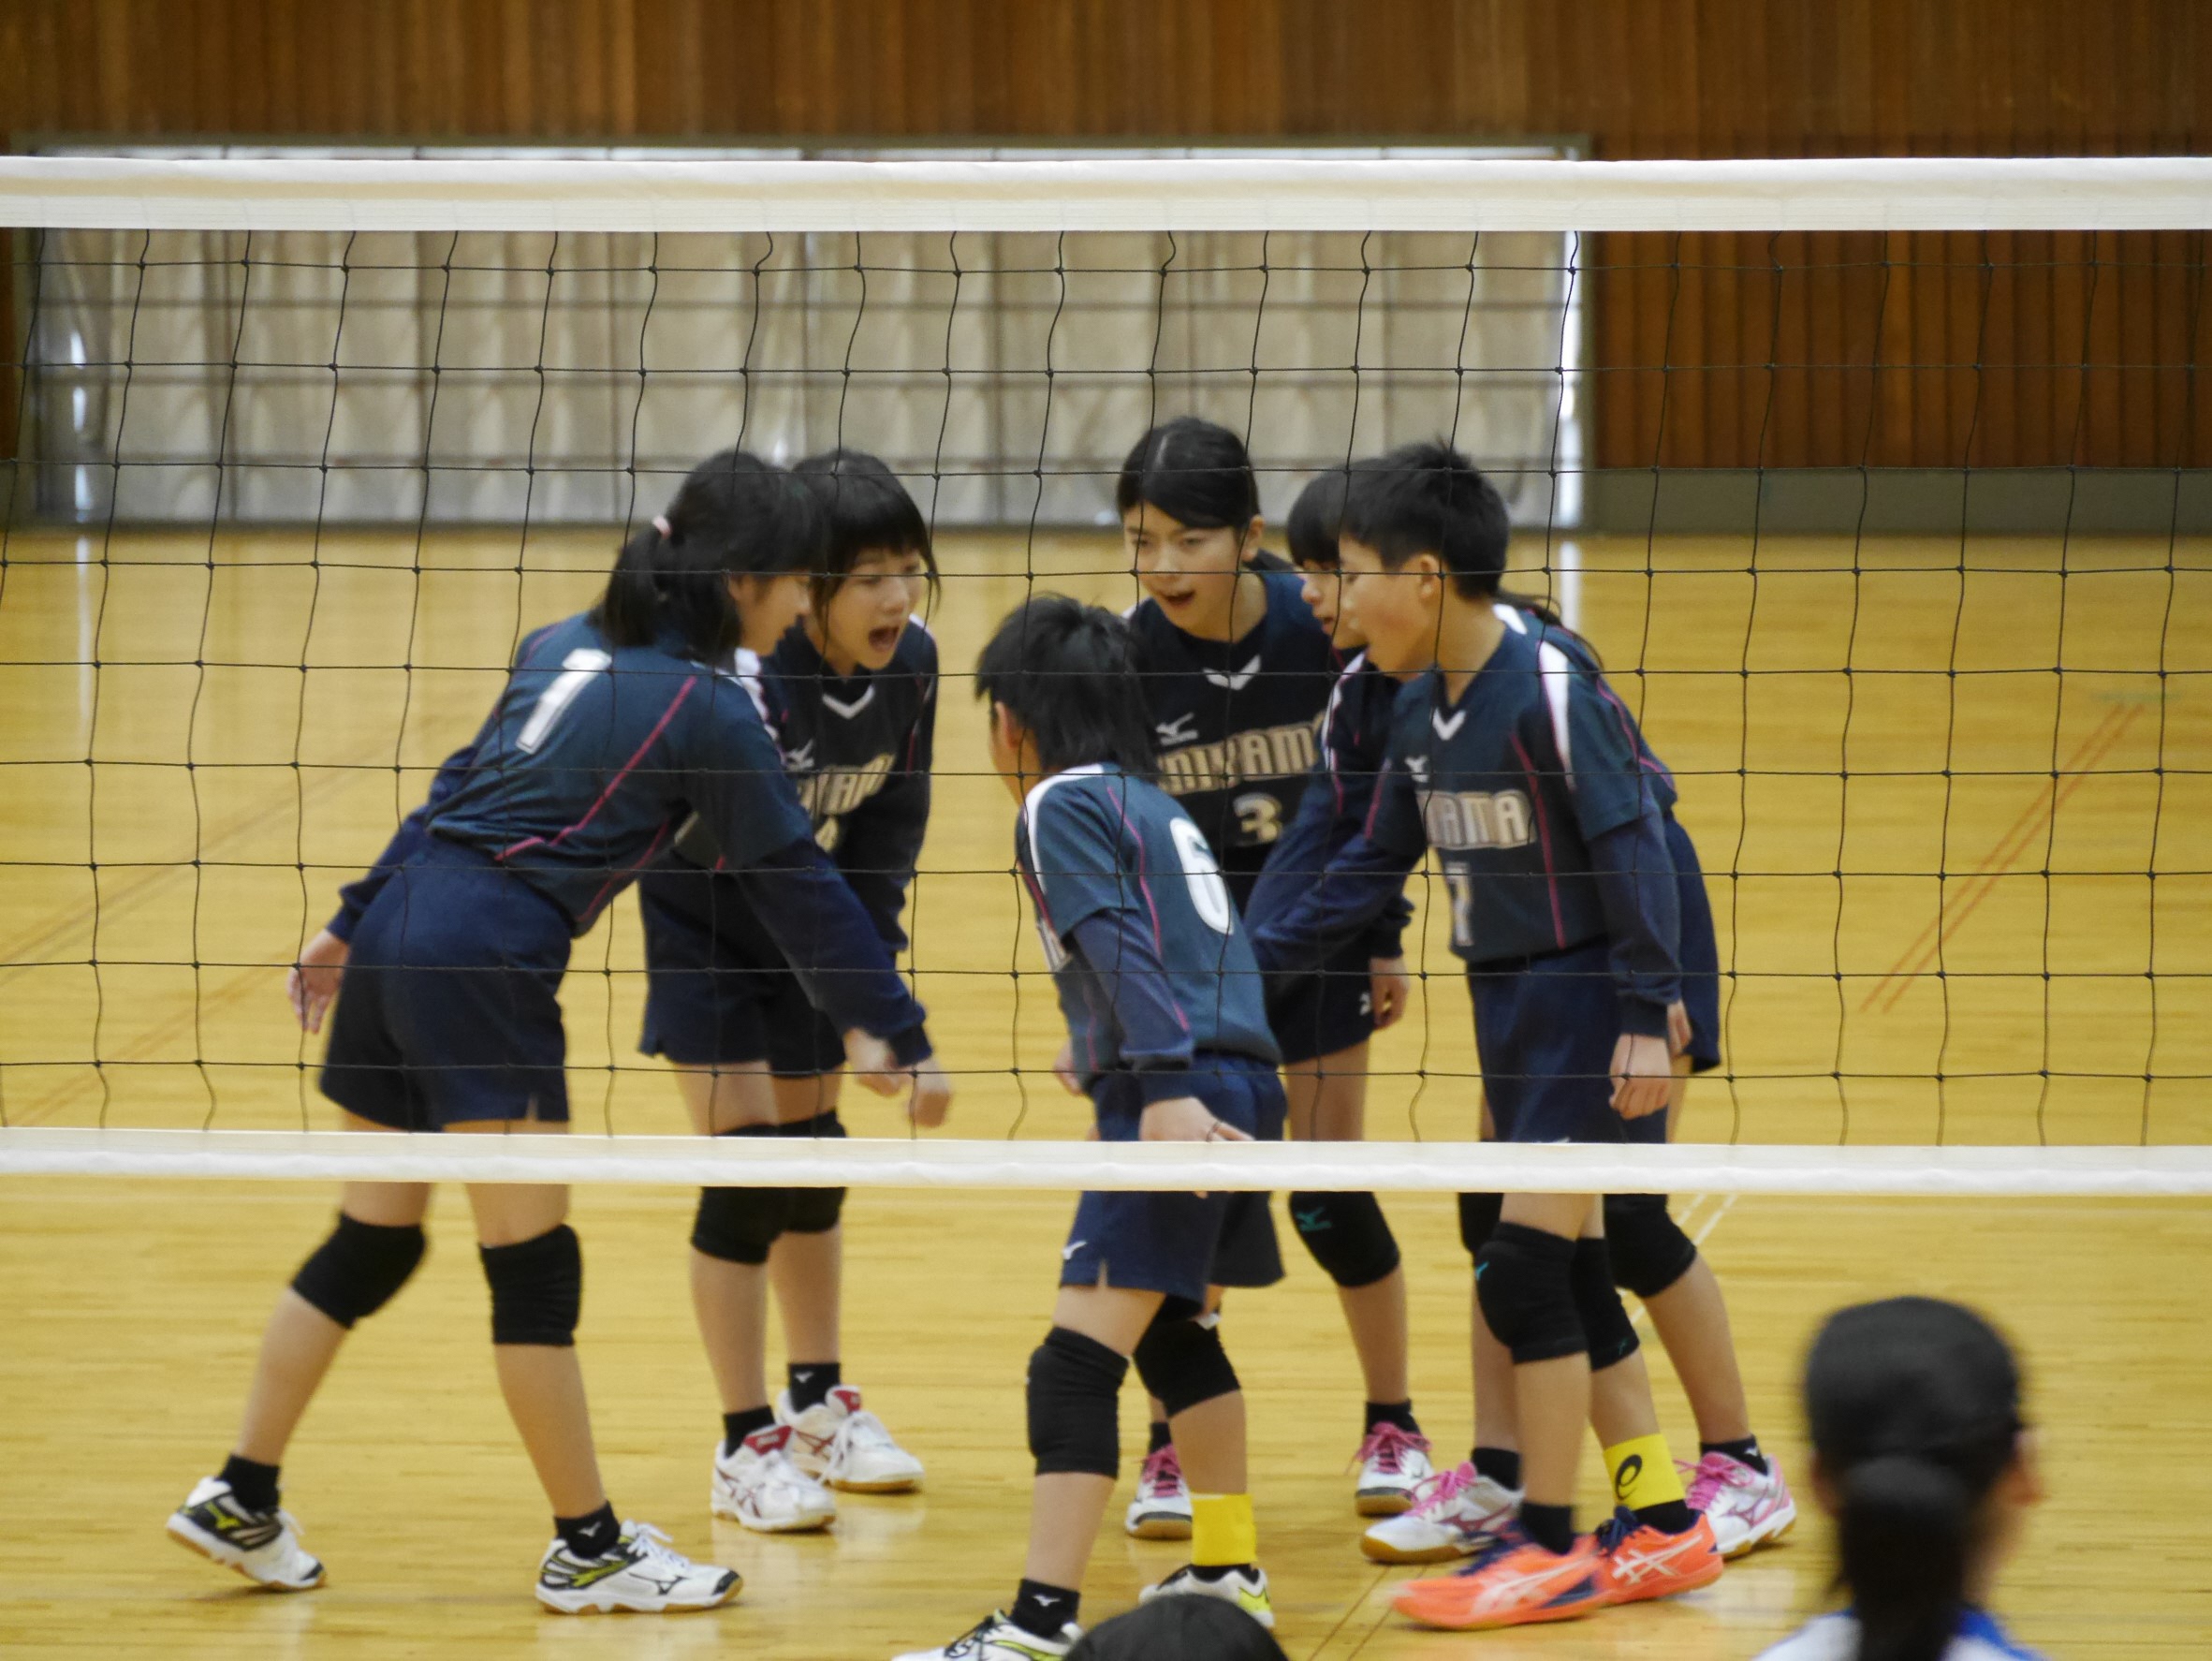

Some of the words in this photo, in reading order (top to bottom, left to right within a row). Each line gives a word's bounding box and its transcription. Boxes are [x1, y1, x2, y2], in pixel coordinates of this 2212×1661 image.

[515, 648, 612, 756] 1
[1234, 792, 1282, 847] 3
[1169, 816, 1235, 936] 6
